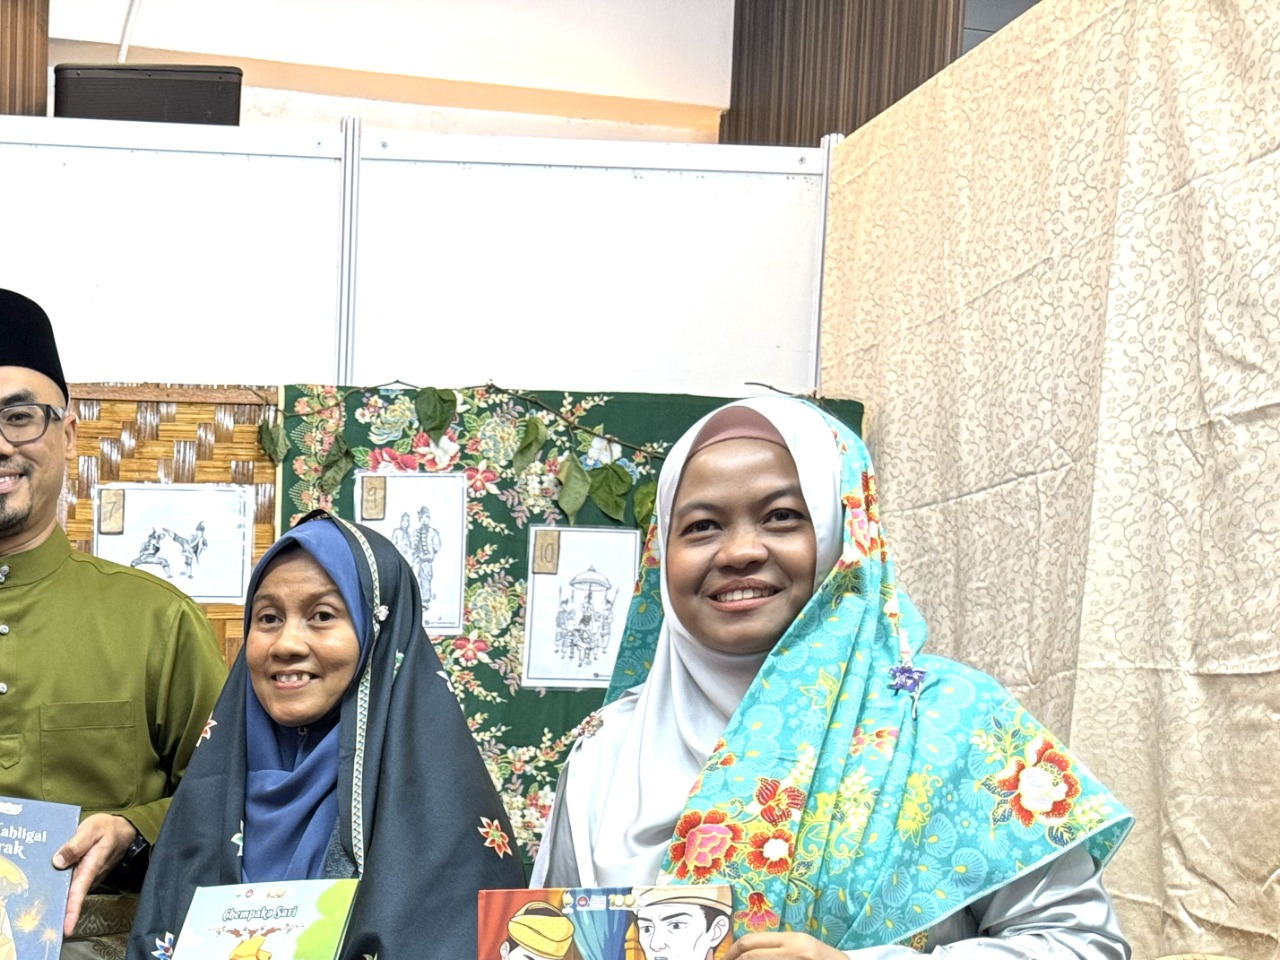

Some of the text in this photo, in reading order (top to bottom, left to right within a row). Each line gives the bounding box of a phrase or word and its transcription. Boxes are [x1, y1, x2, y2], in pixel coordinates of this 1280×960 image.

[106, 501, 117, 521] 7
[540, 543, 554, 563] 10
[222, 905, 298, 921] Chempaka Sari
